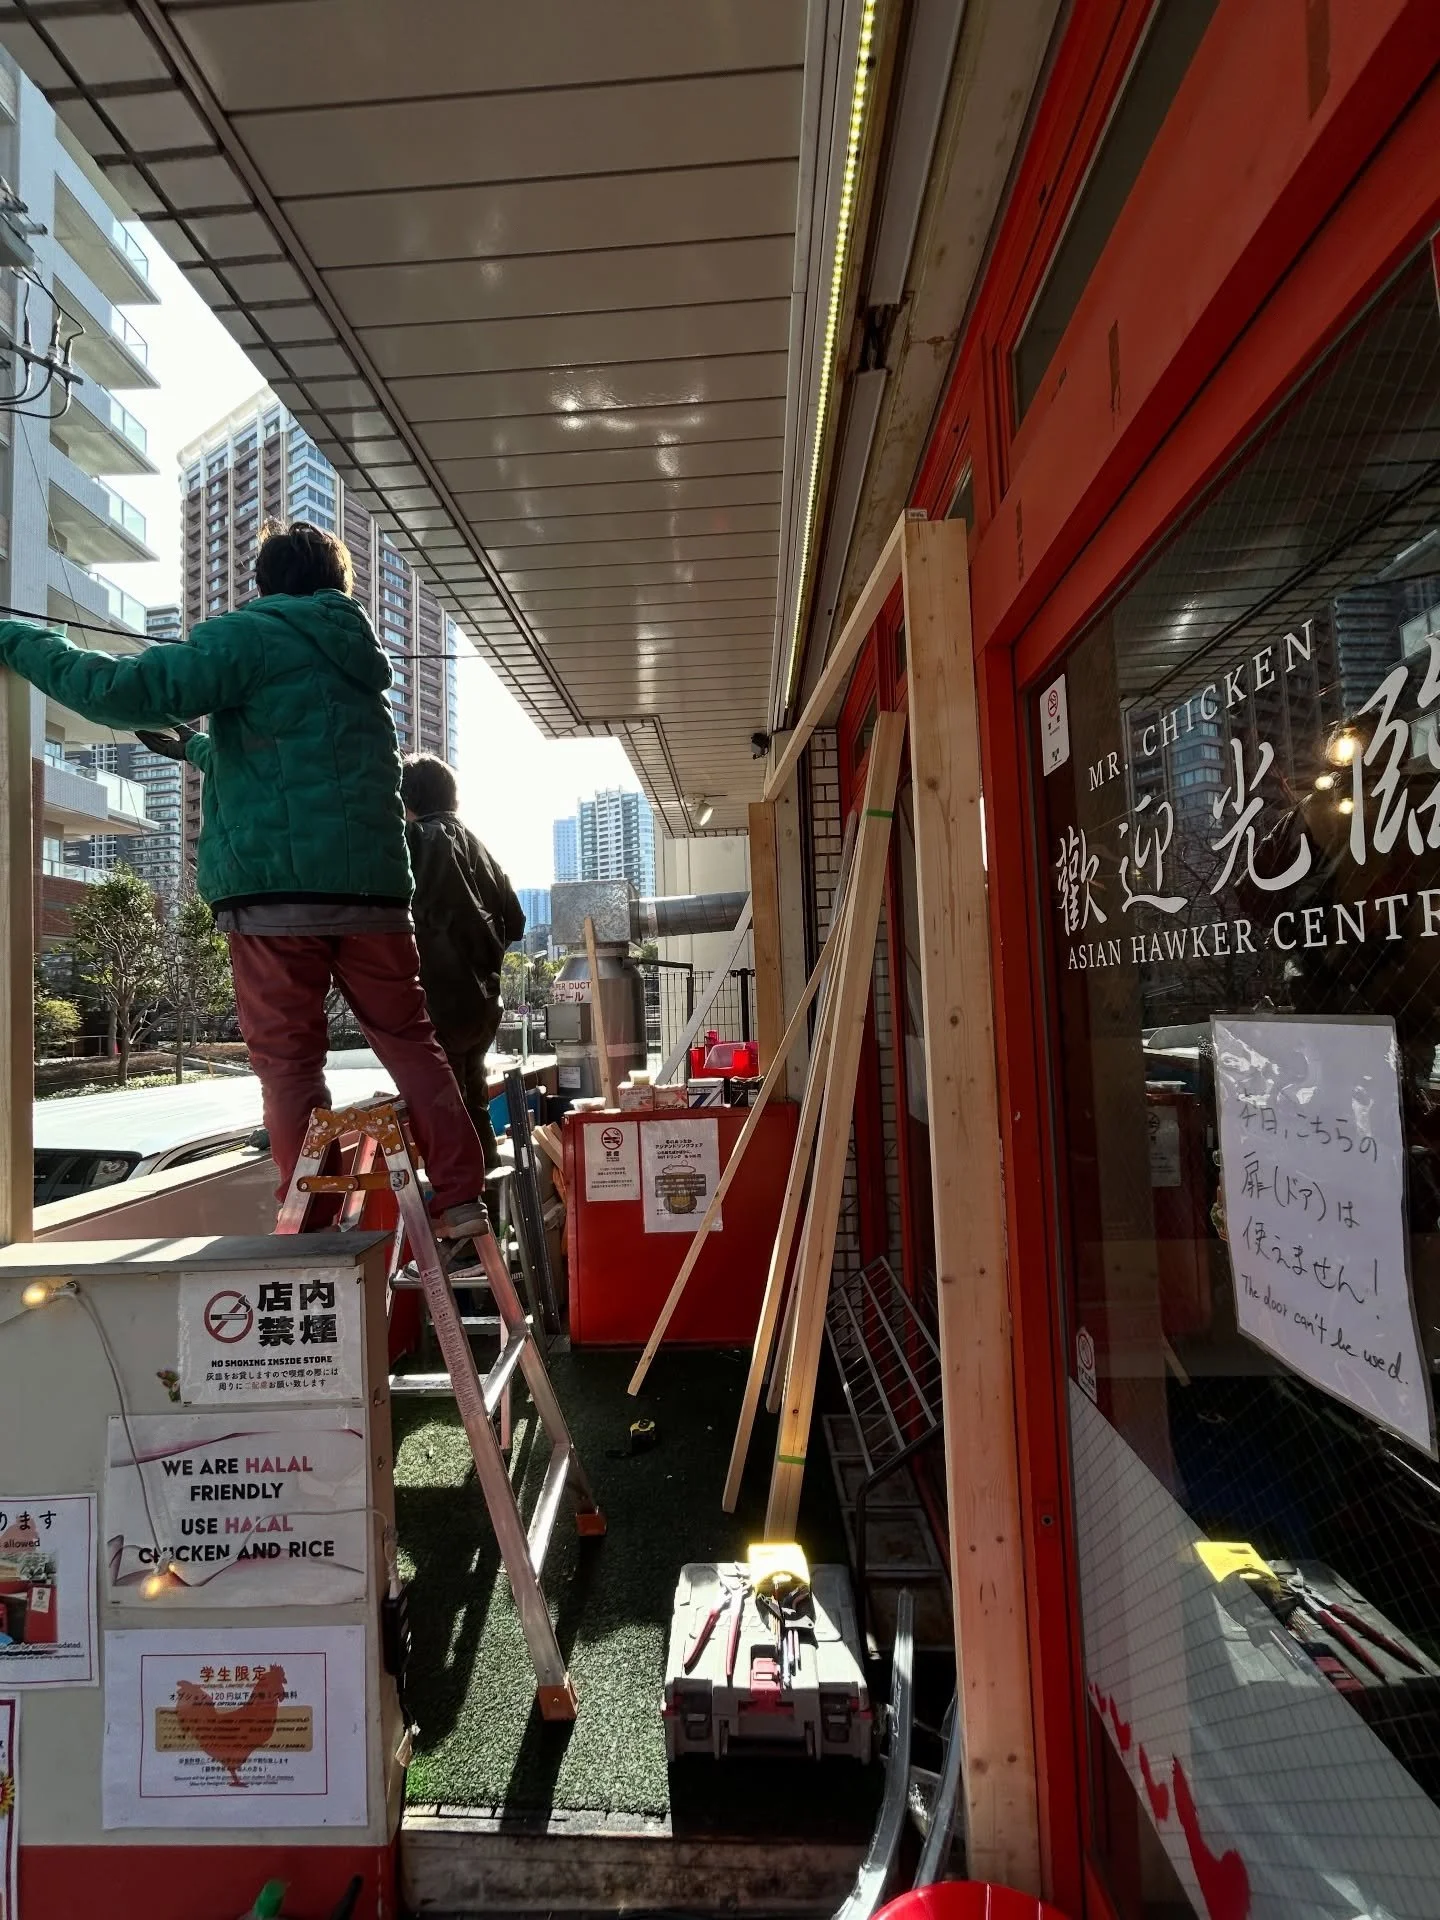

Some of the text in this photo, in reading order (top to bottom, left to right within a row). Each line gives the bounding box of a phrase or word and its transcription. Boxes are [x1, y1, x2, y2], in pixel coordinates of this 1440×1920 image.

[1088, 619, 1313, 792] MR. CHICKEN
[1068, 939, 1121, 970] ASIAN
[1131, 919, 1258, 965] HAWKER
[569, 981, 592, 990] DUCT
[257, 1279, 336, 1312] 店内
[1241, 1273, 1260, 1299] The
[1263, 1285, 1288, 1317] door
[1294, 1312, 1328, 1345] can't
[1331, 1327, 1358, 1357] be
[257, 1313, 338, 1348] 禁煙
[211, 1355, 333, 1368] NO SMOKING INSIDE STORE
[162, 1456, 314, 1476] WE ARE HALAL
[190, 1483, 284, 1501] FRIENDLY
[181, 1515, 294, 1535] USE HALAL
[3, 1537, 41, 1549] allowed
[237, 1542, 281, 1561] AND
[288, 1541, 335, 1559] RICE
[199, 1665, 267, 1683] 学生限定
